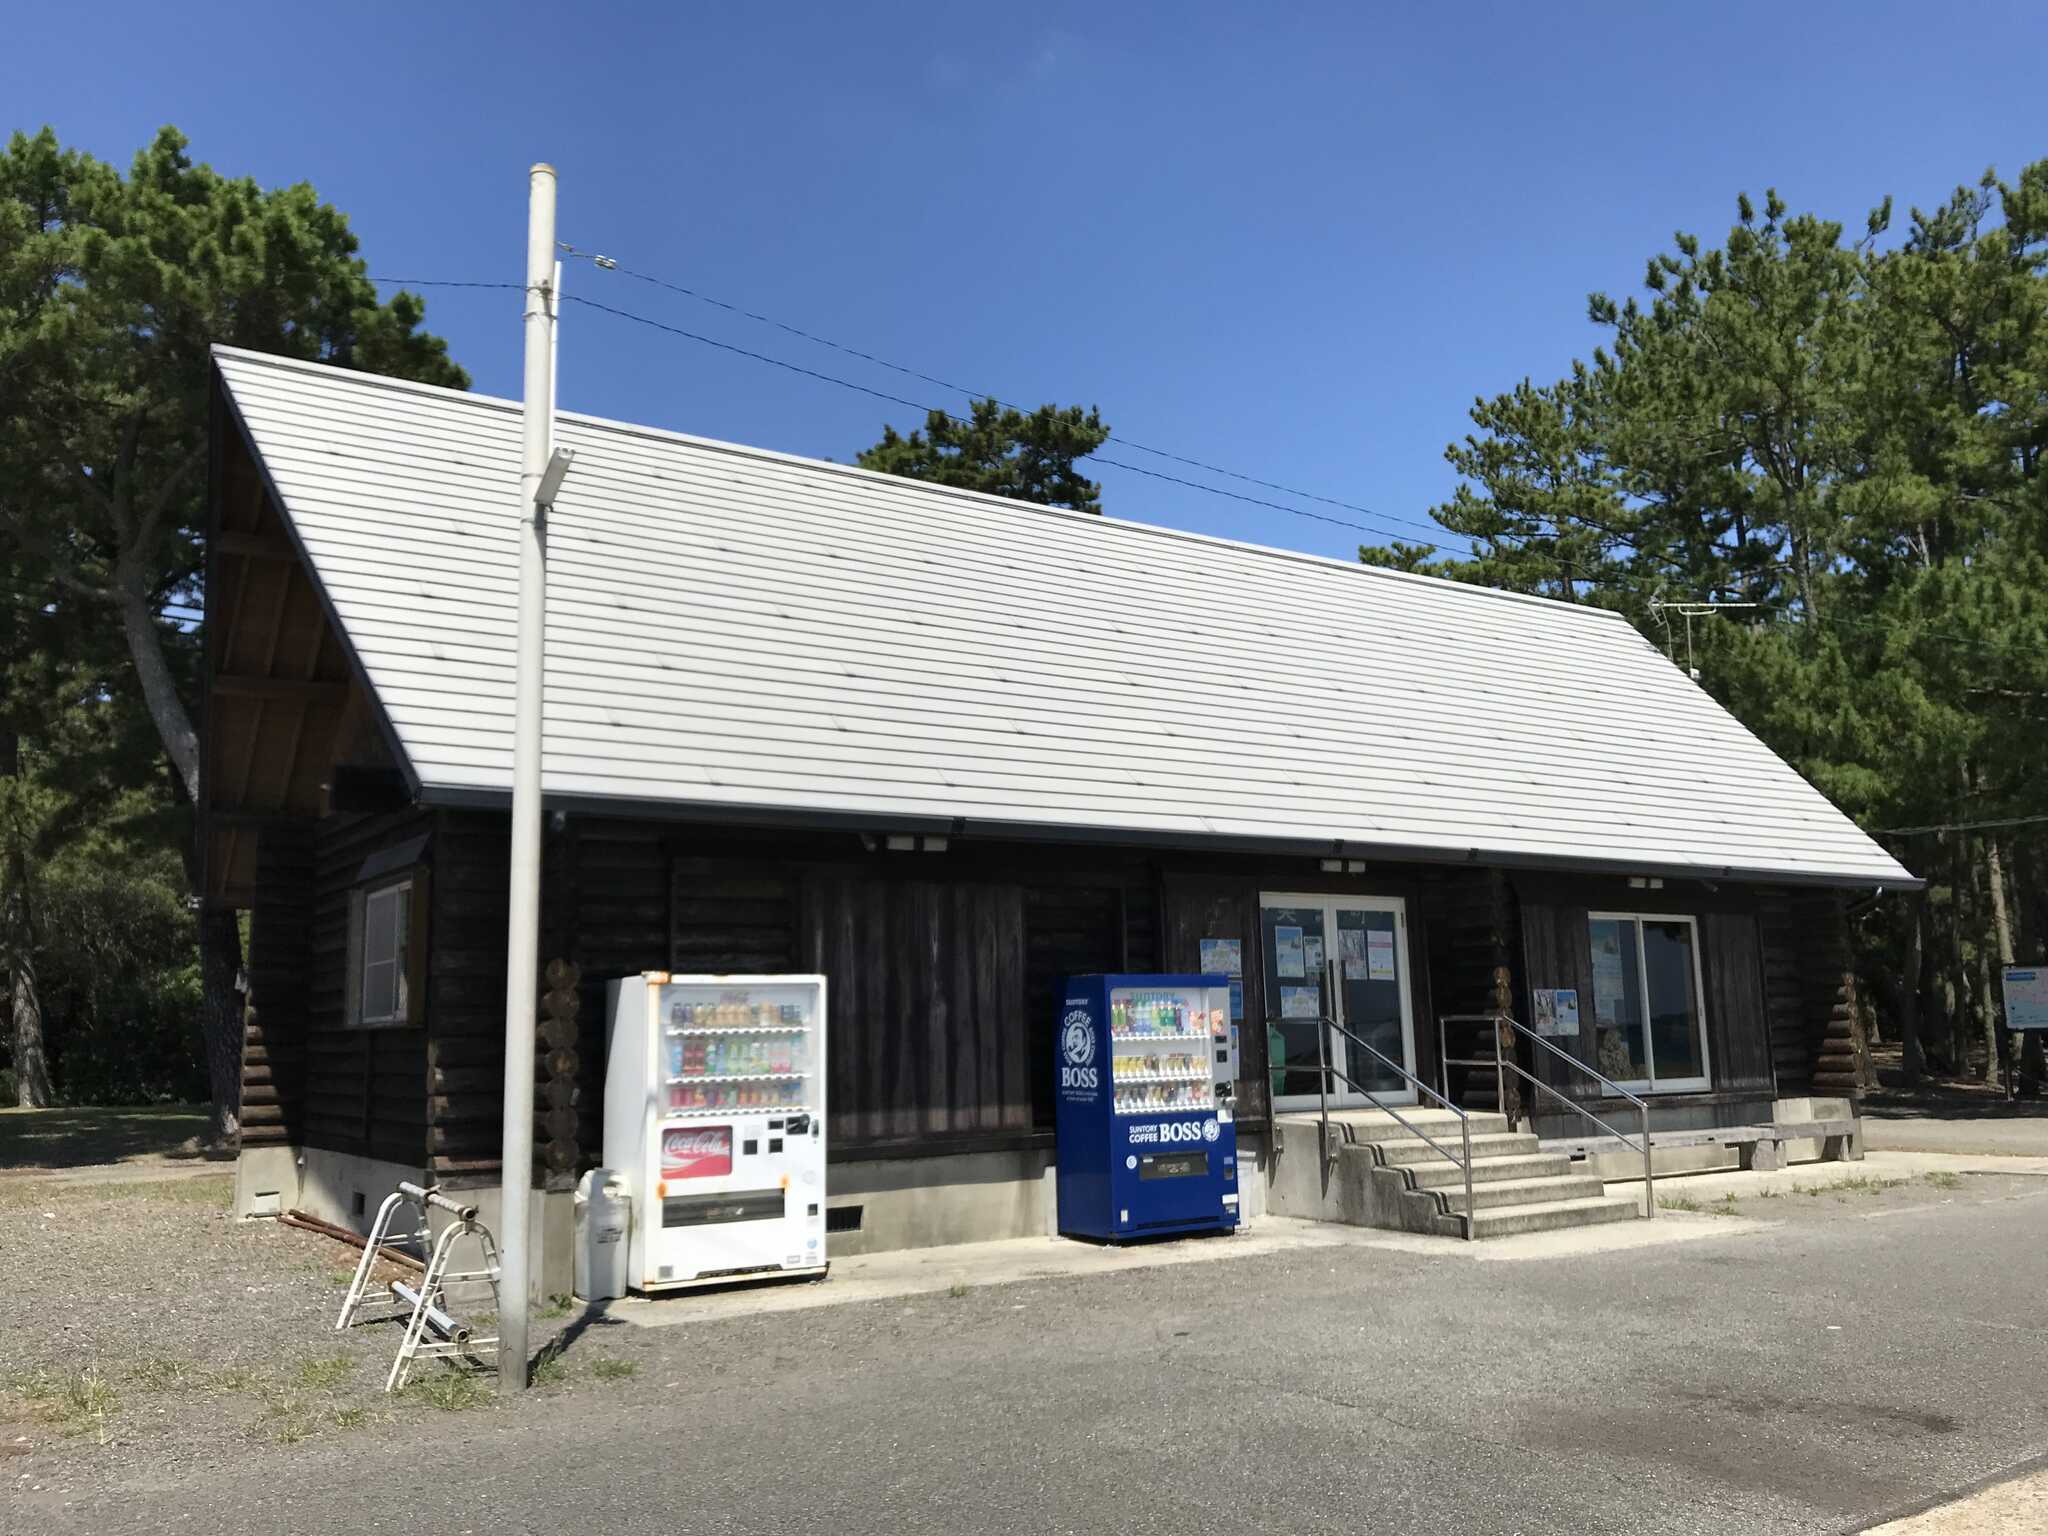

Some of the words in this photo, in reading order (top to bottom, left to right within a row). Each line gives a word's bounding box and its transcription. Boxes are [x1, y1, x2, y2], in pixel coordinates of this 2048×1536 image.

[1064, 1010, 1091, 1027] COFFEE
[1062, 1067, 1098, 1088] BOSS
[1129, 1125, 1157, 1134] SUNTORY
[1129, 1133, 1159, 1143] COFFEE
[1159, 1122, 1201, 1142] BOSS
